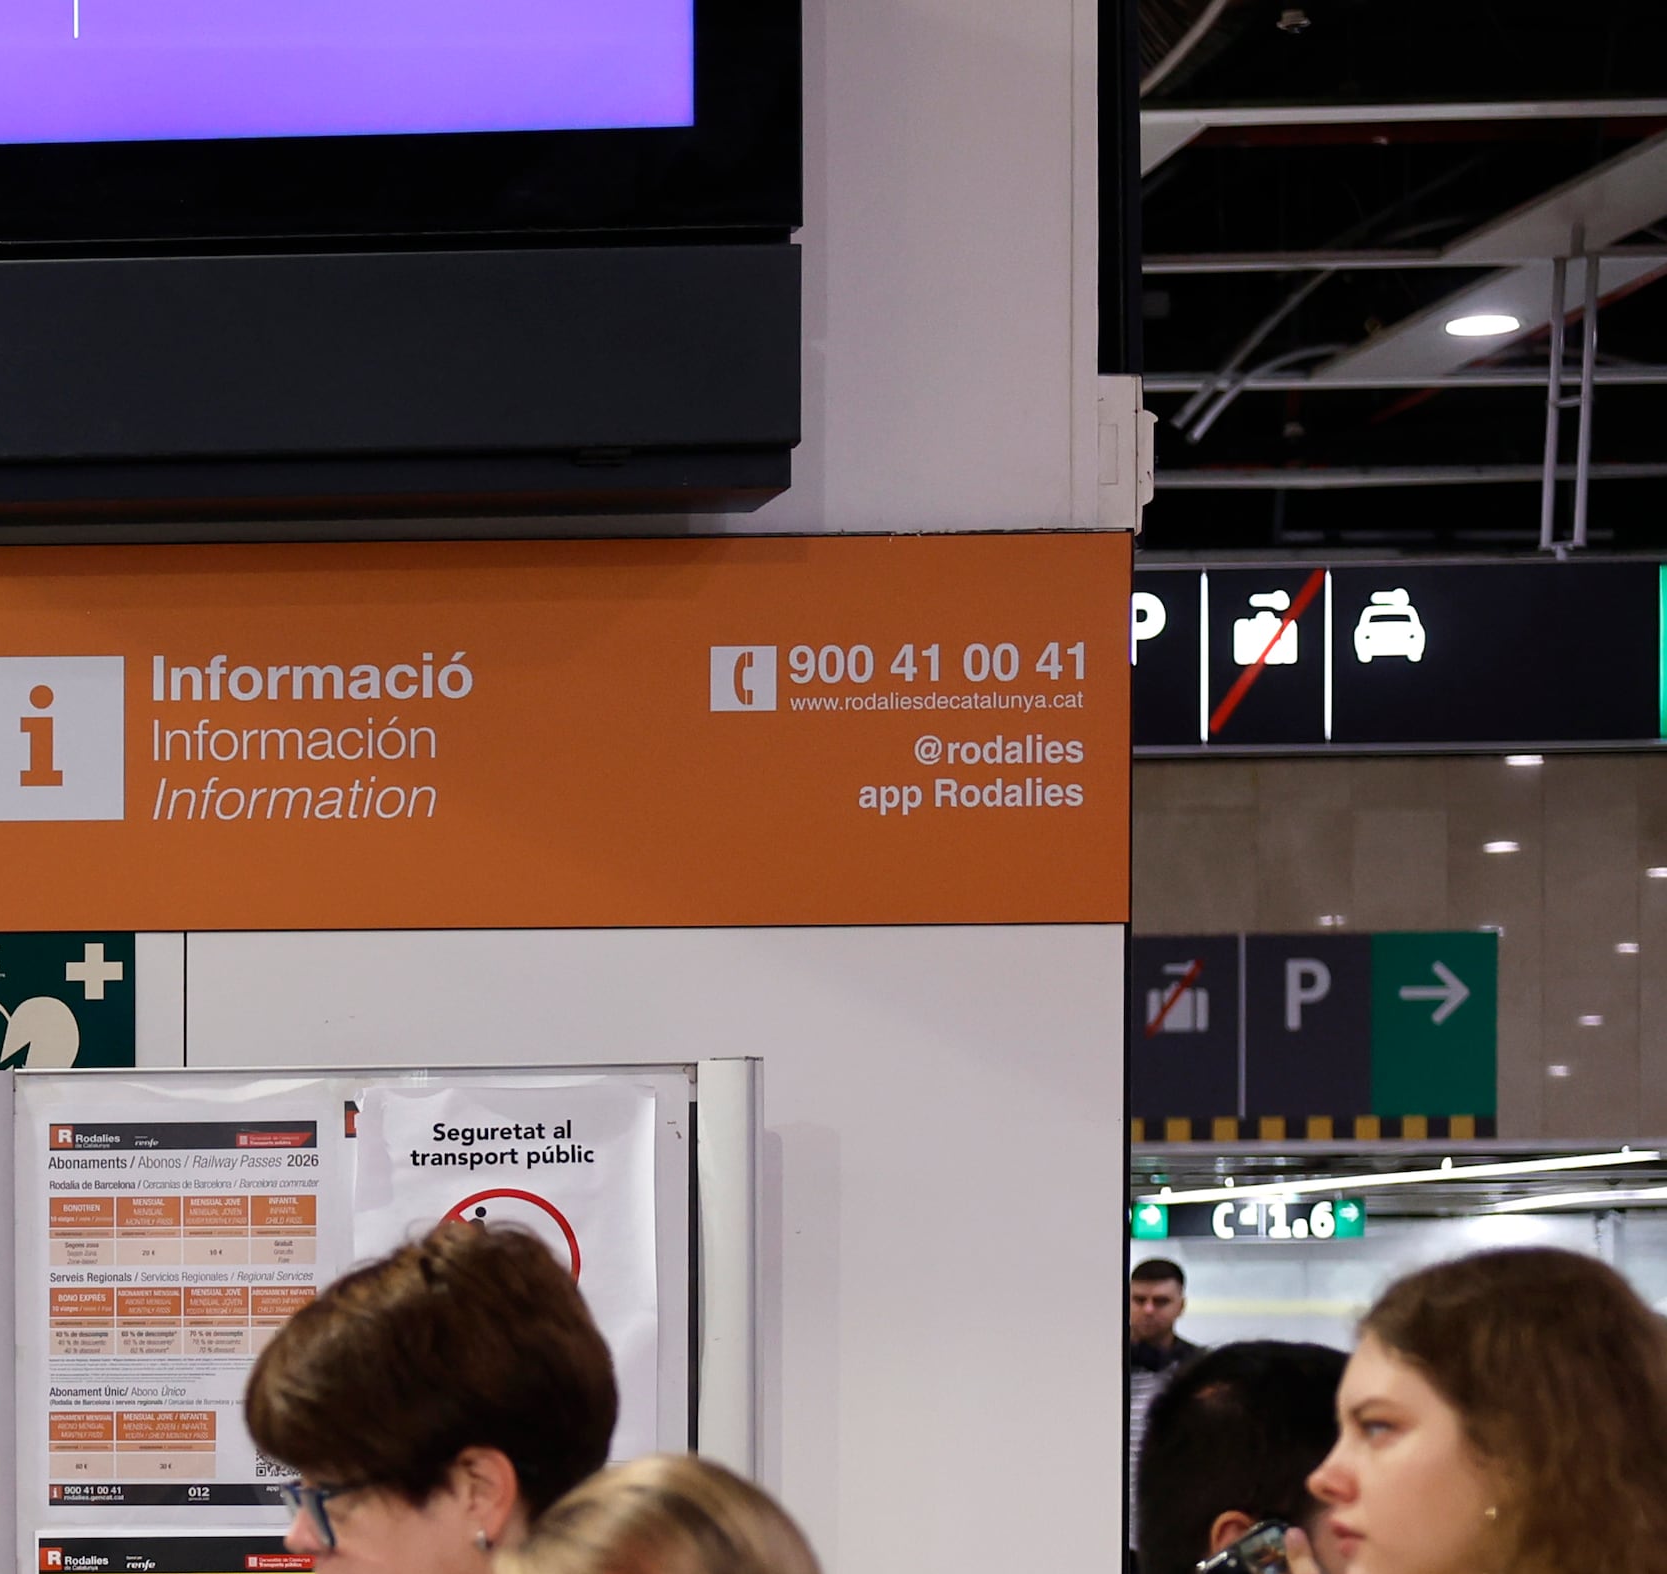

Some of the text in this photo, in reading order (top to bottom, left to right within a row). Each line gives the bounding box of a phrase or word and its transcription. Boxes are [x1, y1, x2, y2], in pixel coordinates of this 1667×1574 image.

[1130, 592, 1166, 666] P
[788, 641, 1086, 686] 900 41 00 41
[151, 653, 473, 704] Informació
[789, 691, 1084, 716] www.rodaliesdecatalunya.cat
[151, 716, 438, 763] Información
[913, 733, 1084, 768] @rodalies
[151, 778, 438, 822] Information
[858, 776, 1084, 816] app Rodalies
[1286, 958, 1331, 1031] P
[75, 1134, 120, 1143] Rodalies
[135, 1138, 159, 1147] renfe
[432, 1120, 572, 1146] Seguretat al
[48, 1156, 127, 1169] Abonaments
[138, 1156, 181, 1169] Abonos
[193, 1155, 239, 1170] Railway
[239, 1155, 282, 1168] Passes
[287, 1154, 319, 1167] 2026
[410, 1145, 595, 1170] transport públic
[188, 1487, 210, 1497] 012
[64, 1556, 108, 1566] Rodalies
[127, 1558, 156, 1571] renfe
